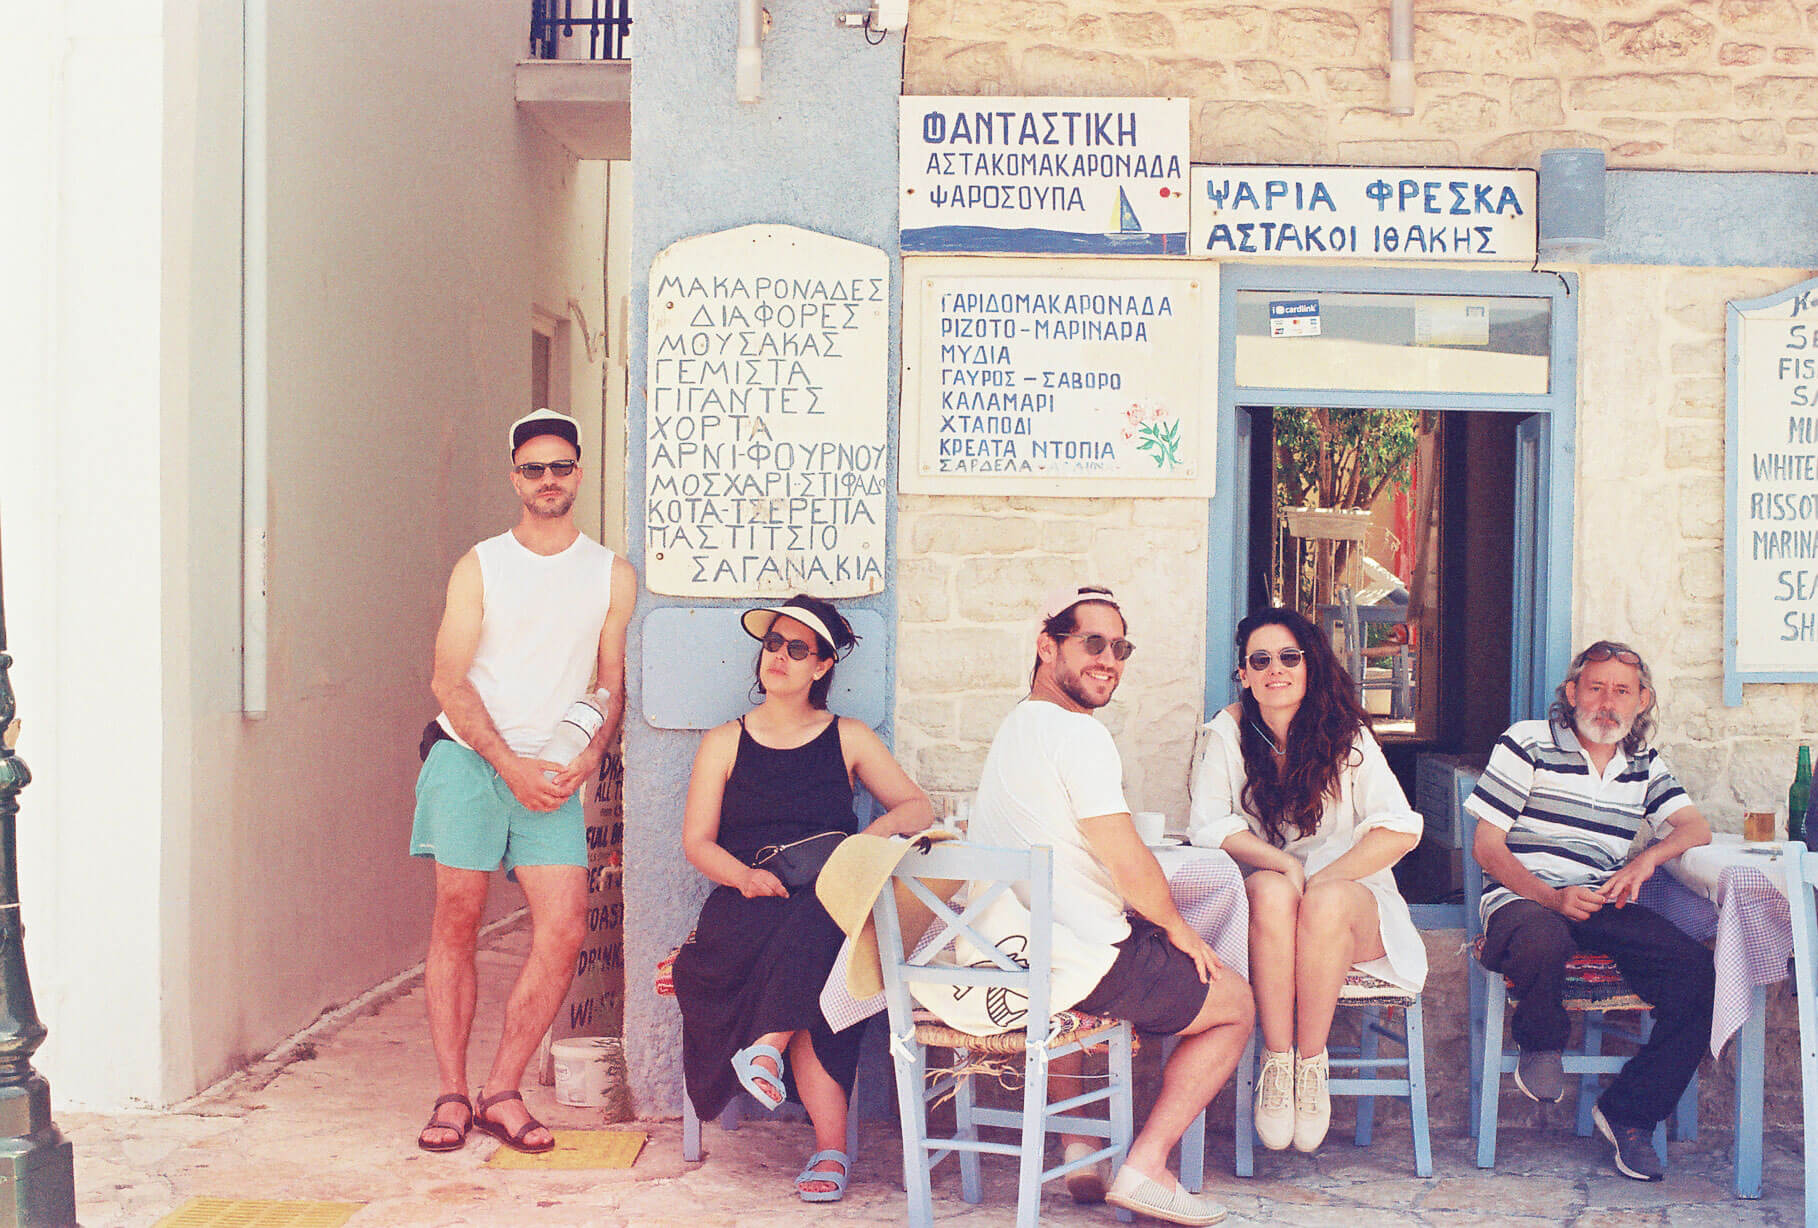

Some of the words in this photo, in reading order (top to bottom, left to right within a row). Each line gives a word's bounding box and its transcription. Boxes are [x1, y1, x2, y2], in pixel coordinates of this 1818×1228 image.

[923, 111, 1137, 146] ΦΑΝΤΑΣΤΙΚΗ
[926, 152, 1181, 179] ΑΣΤΑΚΟΜΑΚΑΡΟΝΑΔΑ
[930, 184, 1085, 211] ΨΑΡΟΣΟΥΠΑ
[1207, 179, 1337, 212] ΨΑΡΙΑ
[1366, 179, 1524, 216] ΦΡΕΣΚΑ
[1206, 222, 1356, 252] ΑΣΤΑΚΟΙ
[1374, 224, 1496, 254] ΙΘΑΚΗΣ
[657, 275, 884, 301] ΜΑΚΑΡΟΝΑΔΕΣ
[690, 300, 859, 329] ΔΙΑΦΟΡΕΣ
[941, 293, 1172, 317] ΓΑΡΙΔΟΜΑΚΑΡΟΝΑΔΑ
[657, 331, 843, 358] ΜΟΥΣΑΚΑΣ
[941, 344, 1011, 365] ΜΥΔΙΑ
[656, 359, 811, 385] ΓΕΜΙΣΤΑ
[941, 369, 1016, 387] ΓΑΥΡΟΣ
[1042, 371, 1121, 390] ΣΑΒΟΡΟ
[655, 387, 825, 414] ΓΙΓΑΝΤΕΣ
[941, 391, 1054, 413] ΚΑΛΑΜΑΡΙ
[650, 415, 773, 441] ΧΟΡΤΑ
[940, 415, 1031, 435] ΧΤΑΠΟΔΙ
[940, 438, 1017, 459] ΚΡΕΑΤΑ
[1032, 440, 1116, 460] ΝΤΟΠΙΑ
[940, 458, 1032, 472] ΣΑΡΔΕΛΑ
[1753, 453, 1818, 481] WHITE
[648, 525, 837, 551] ΠΑΣΤΙΤΣΙΟ
[692, 554, 882, 583] ΣΑΓΑΝΑΚΙΑ
